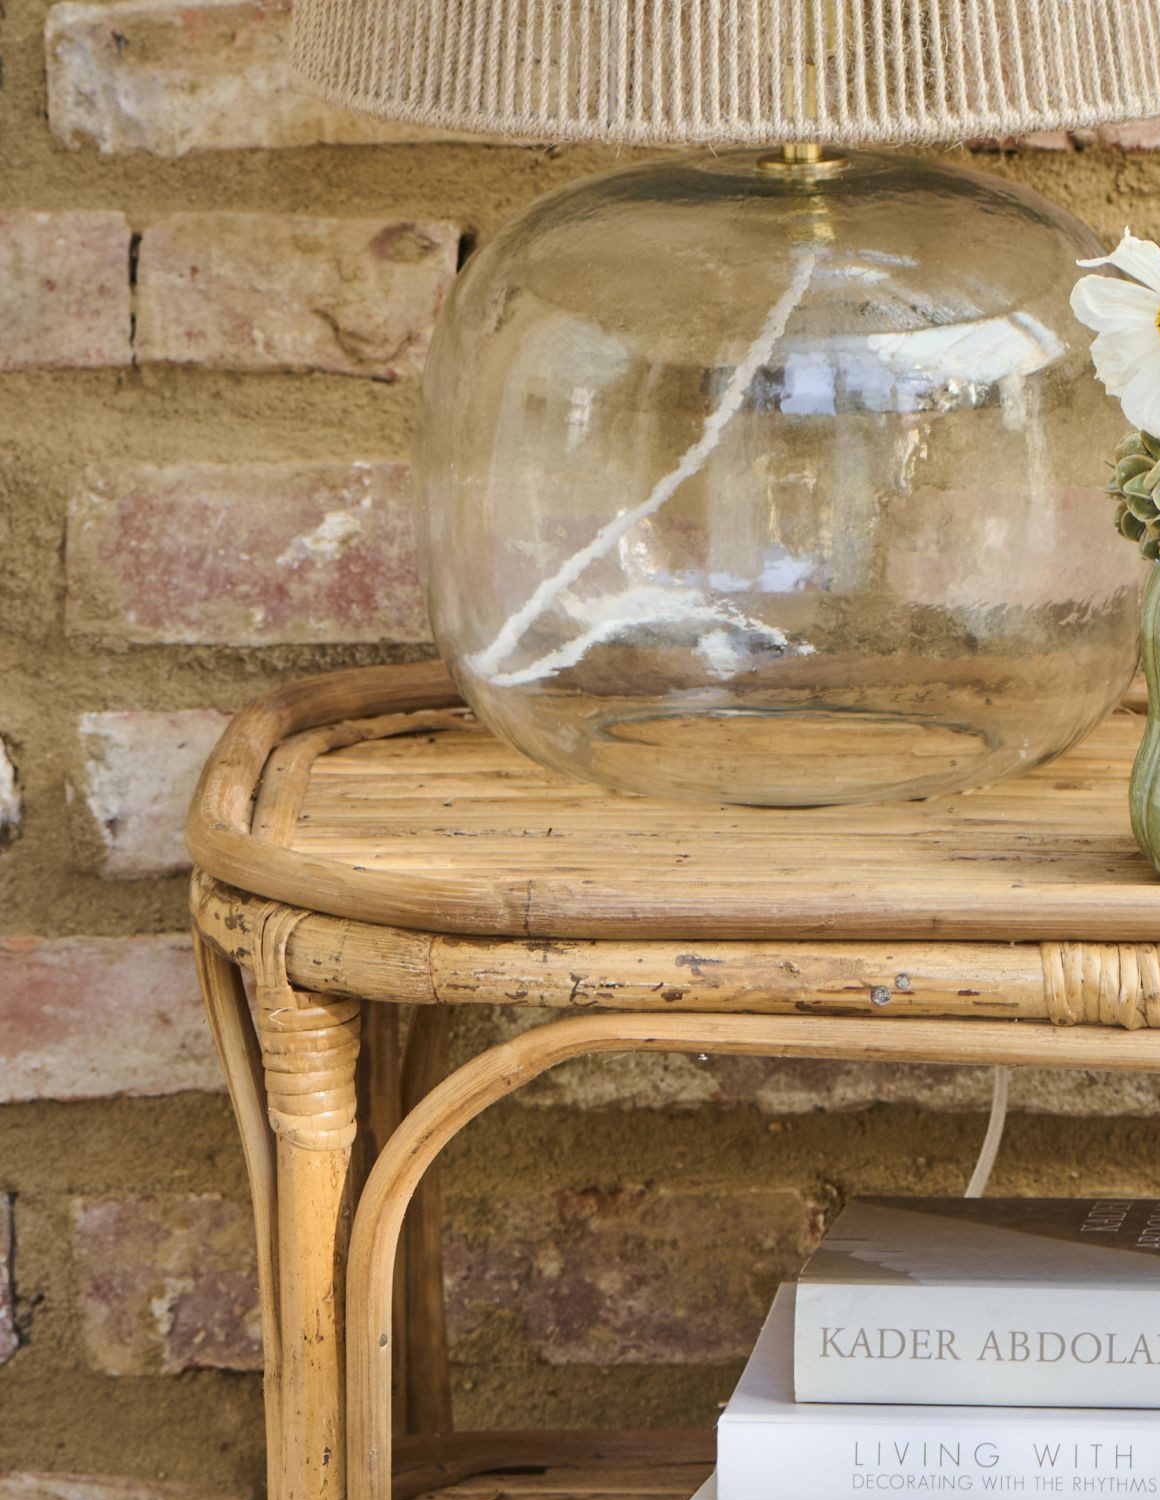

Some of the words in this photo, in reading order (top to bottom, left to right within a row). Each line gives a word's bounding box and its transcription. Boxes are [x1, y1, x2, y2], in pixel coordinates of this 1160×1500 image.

[819, 1326, 961, 1361] KADER
[854, 1441, 1000, 1468] LIVING
[1033, 1443, 1133, 1470] WITH
[852, 1474, 973, 1491] DECORATING
[982, 1475, 1025, 1492] WITH
[1033, 1476, 1064, 1492] THE
[1073, 1476, 1158, 1494] RHYTHMS
